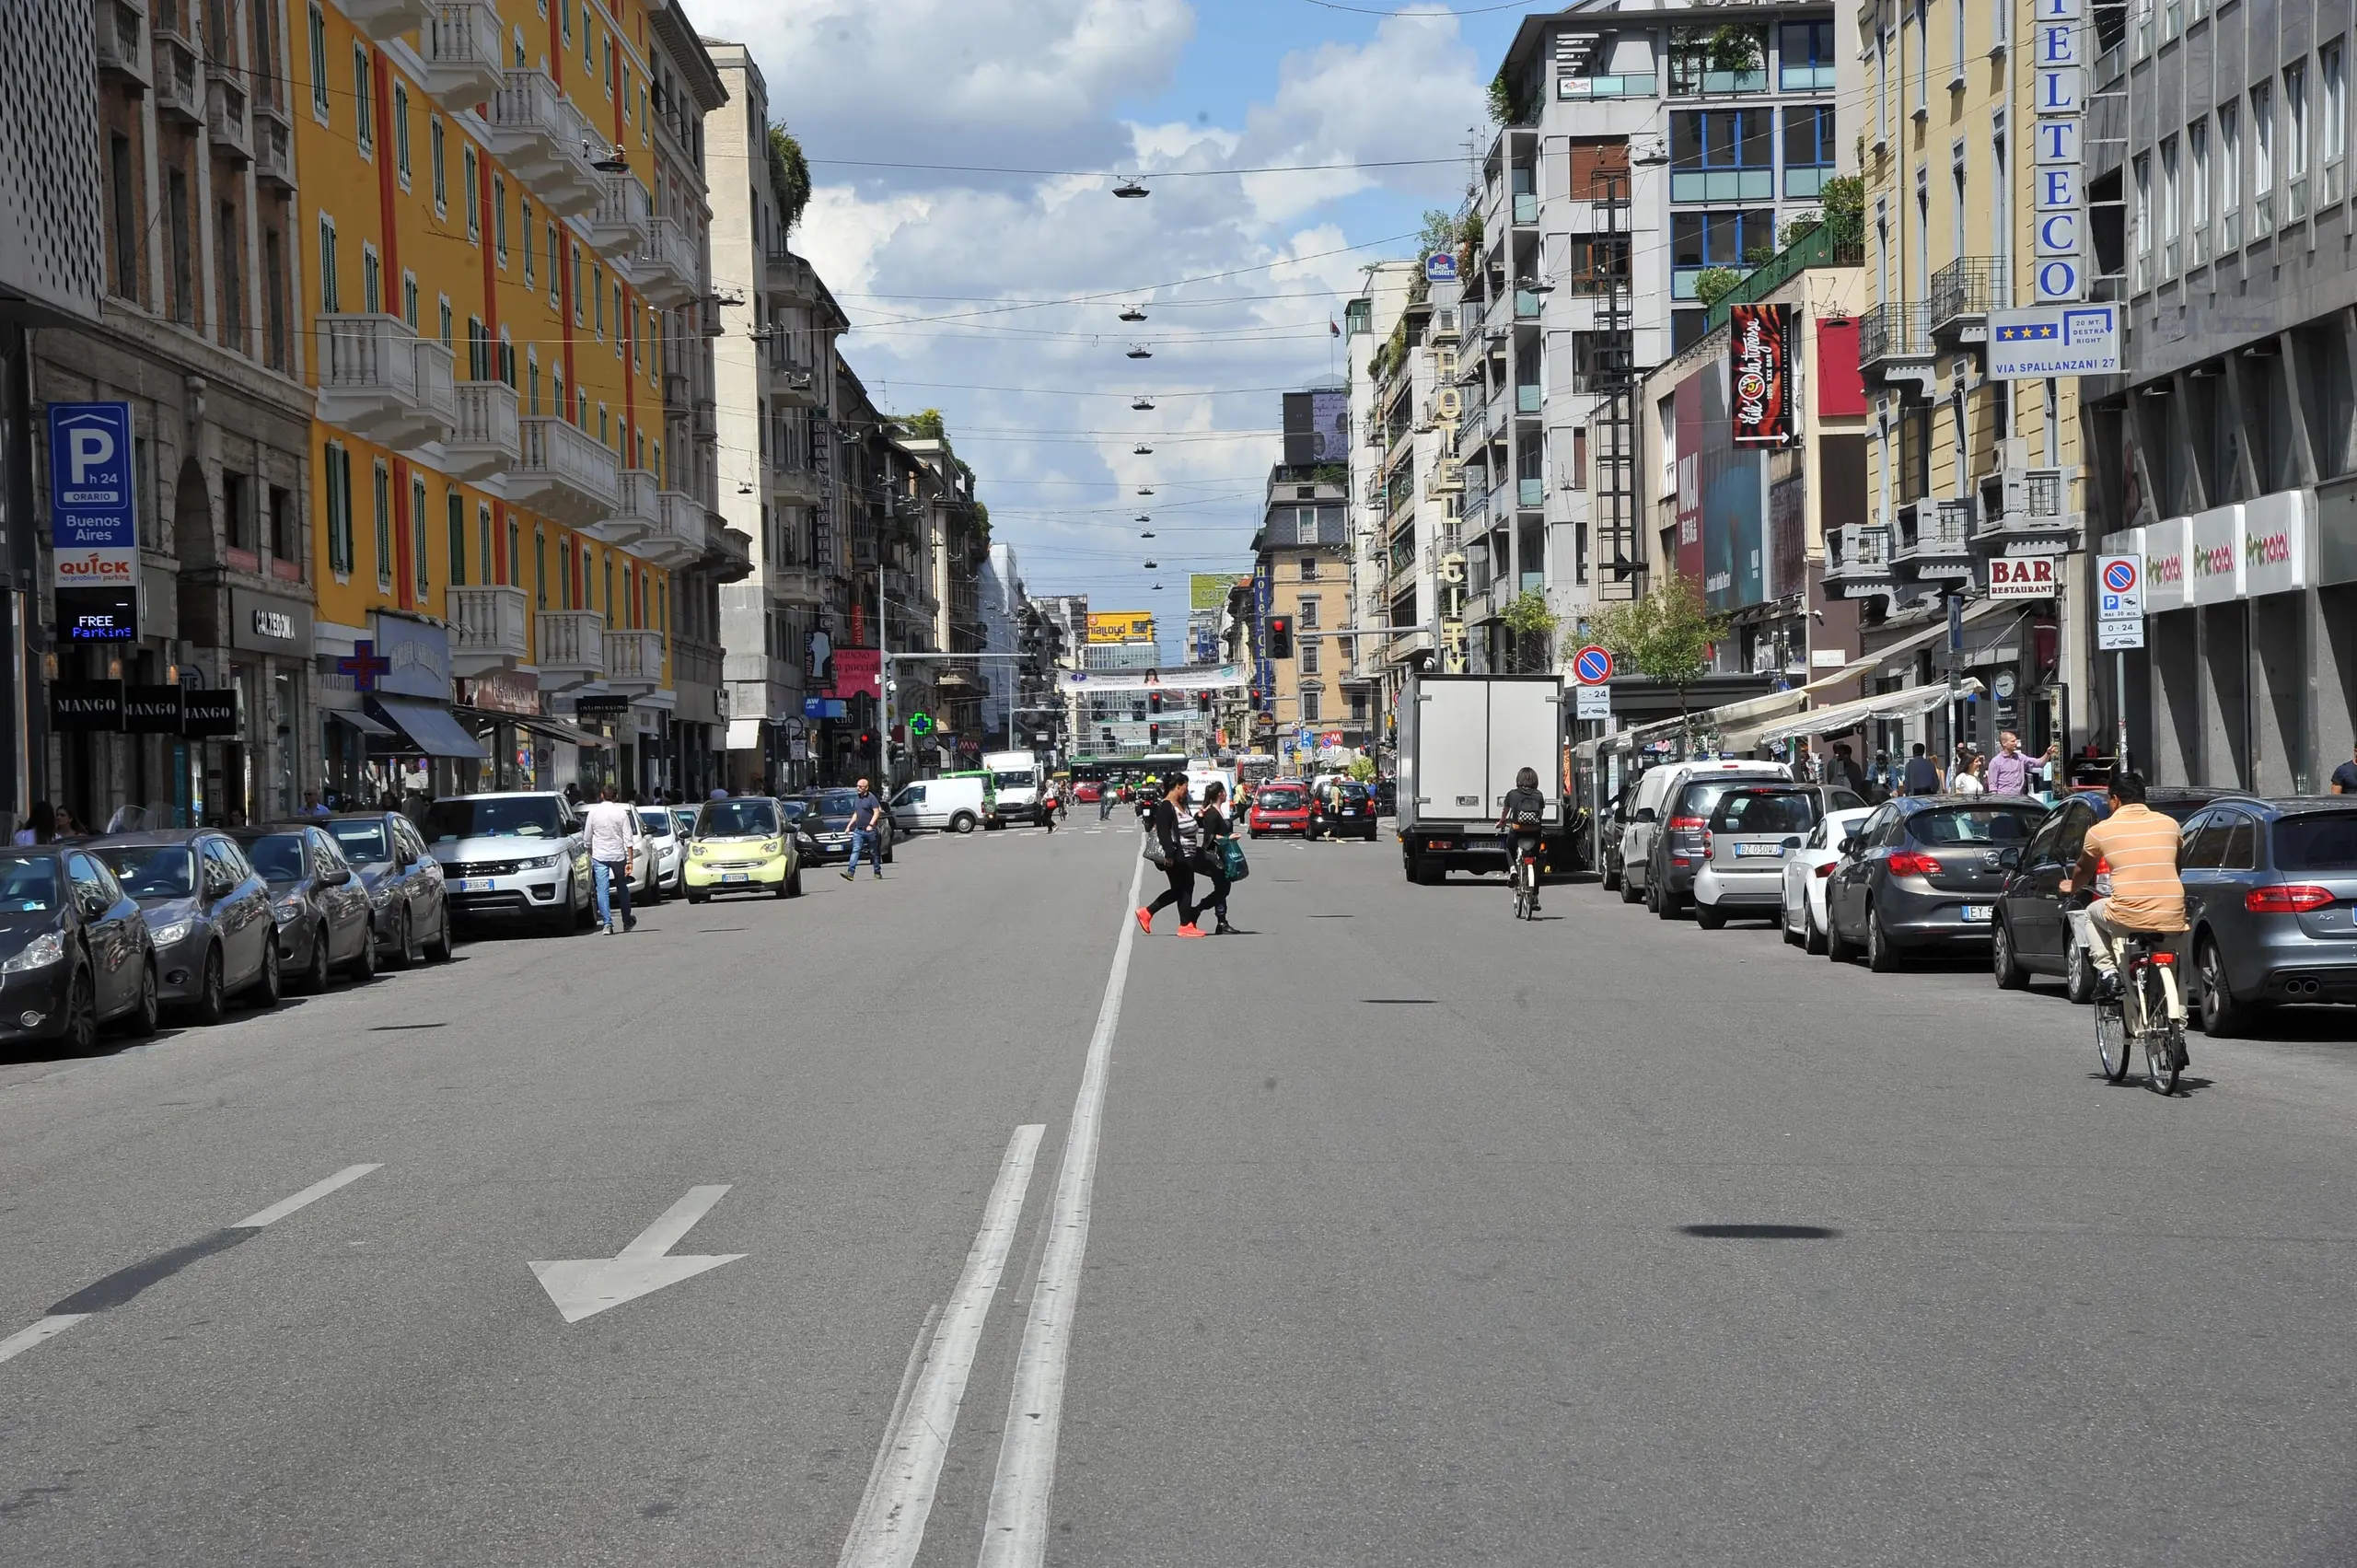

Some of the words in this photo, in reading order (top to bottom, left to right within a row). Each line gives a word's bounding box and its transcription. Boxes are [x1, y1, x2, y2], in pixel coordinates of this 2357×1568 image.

[2040, 124, 2074, 296] TECO
[1429, 268, 1455, 276] Western
[1996, 365, 2015, 374] VIA
[2020, 359, 2097, 372] SPALLANZANI
[2102, 358, 2115, 368] 27
[70, 428, 114, 484] P
[100, 473, 118, 484] 24
[73, 493, 110, 501] ORARIO
[66, 515, 121, 527] Buenos
[75, 528, 112, 540] Aires
[59, 555, 130, 575] QUICK
[1991, 561, 2052, 583] BAR
[1991, 586, 2053, 594] RESTAURANT
[2107, 597, 2117, 609] P
[79, 616, 113, 626] FREE
[58, 698, 116, 713] MANGO
[1741, 845, 1750, 854] BZ
[1970, 907, 1982, 917] EY
